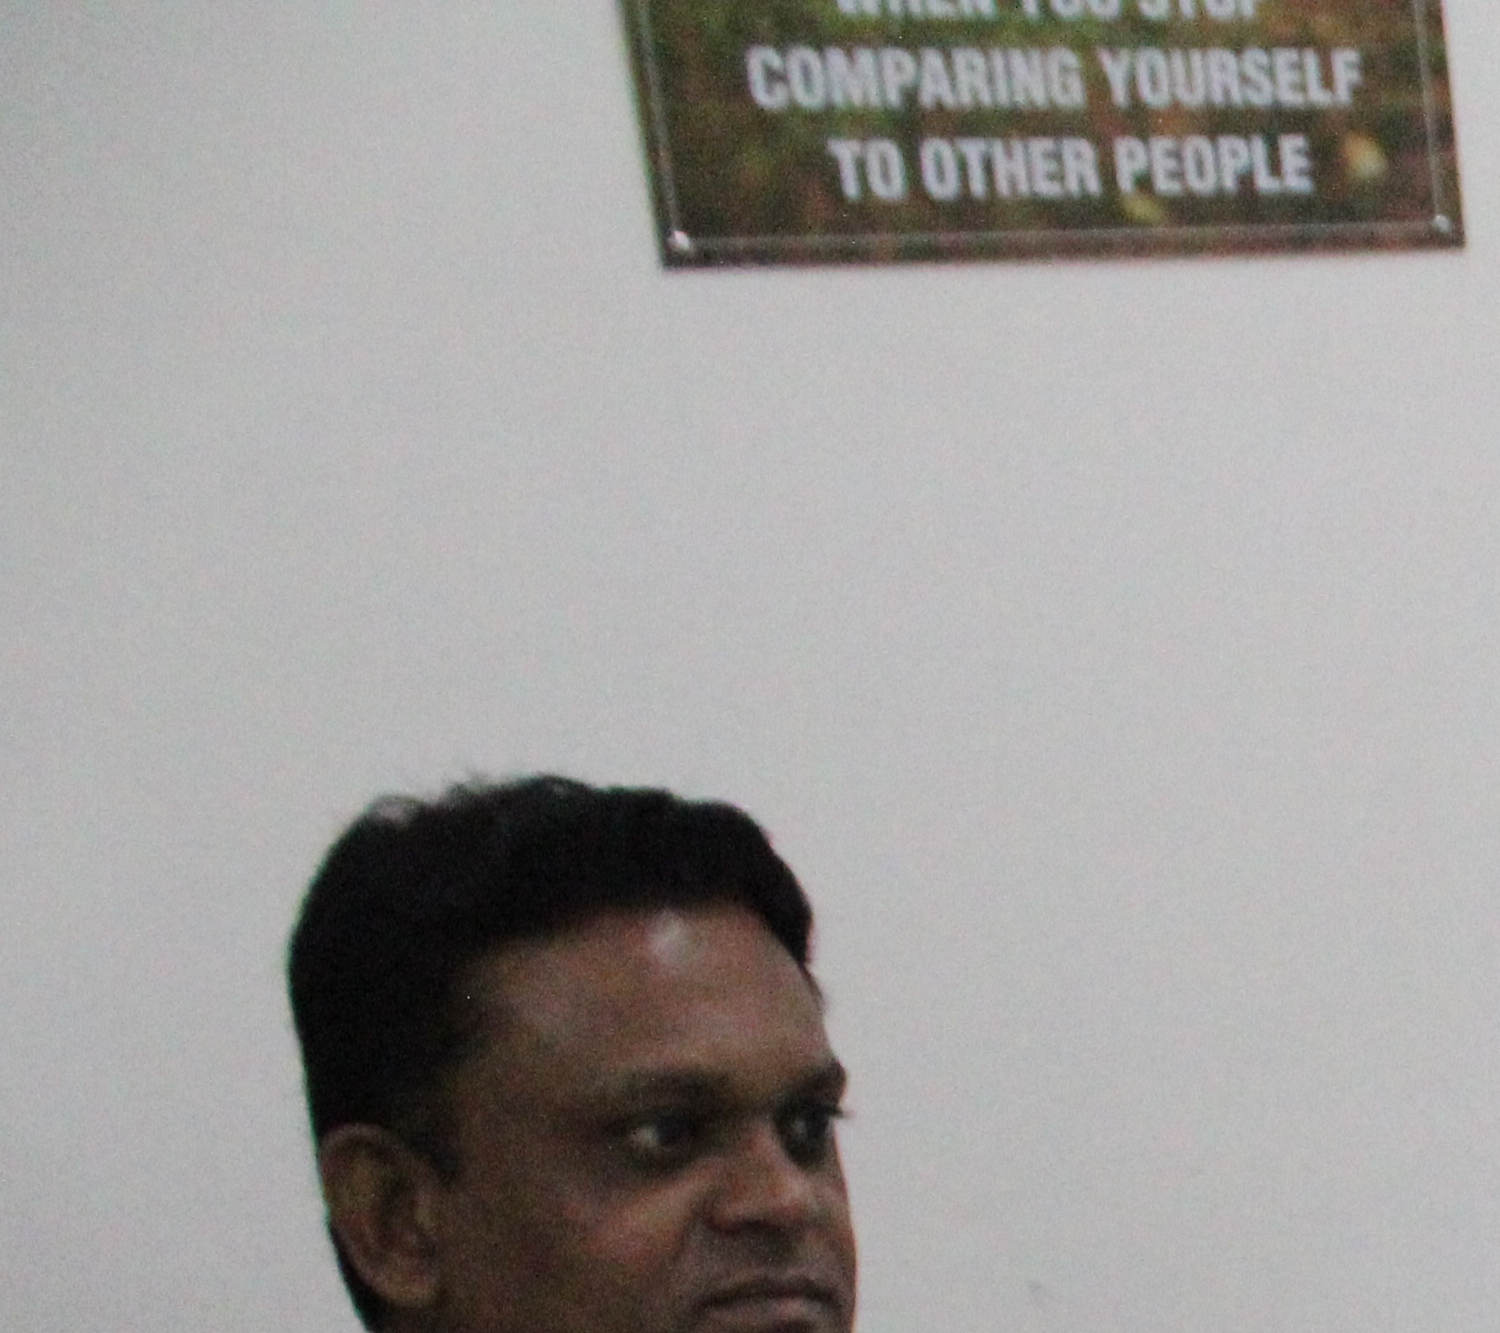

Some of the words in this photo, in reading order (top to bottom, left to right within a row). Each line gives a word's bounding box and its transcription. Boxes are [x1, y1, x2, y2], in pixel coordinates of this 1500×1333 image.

[746, 44, 1085, 111] COMPARING
[1098, 46, 1363, 108] YOURSELF
[828, 136, 904, 200] TO
[920, 135, 1102, 199] OTHER
[1115, 132, 1314, 195] PEOPLE
